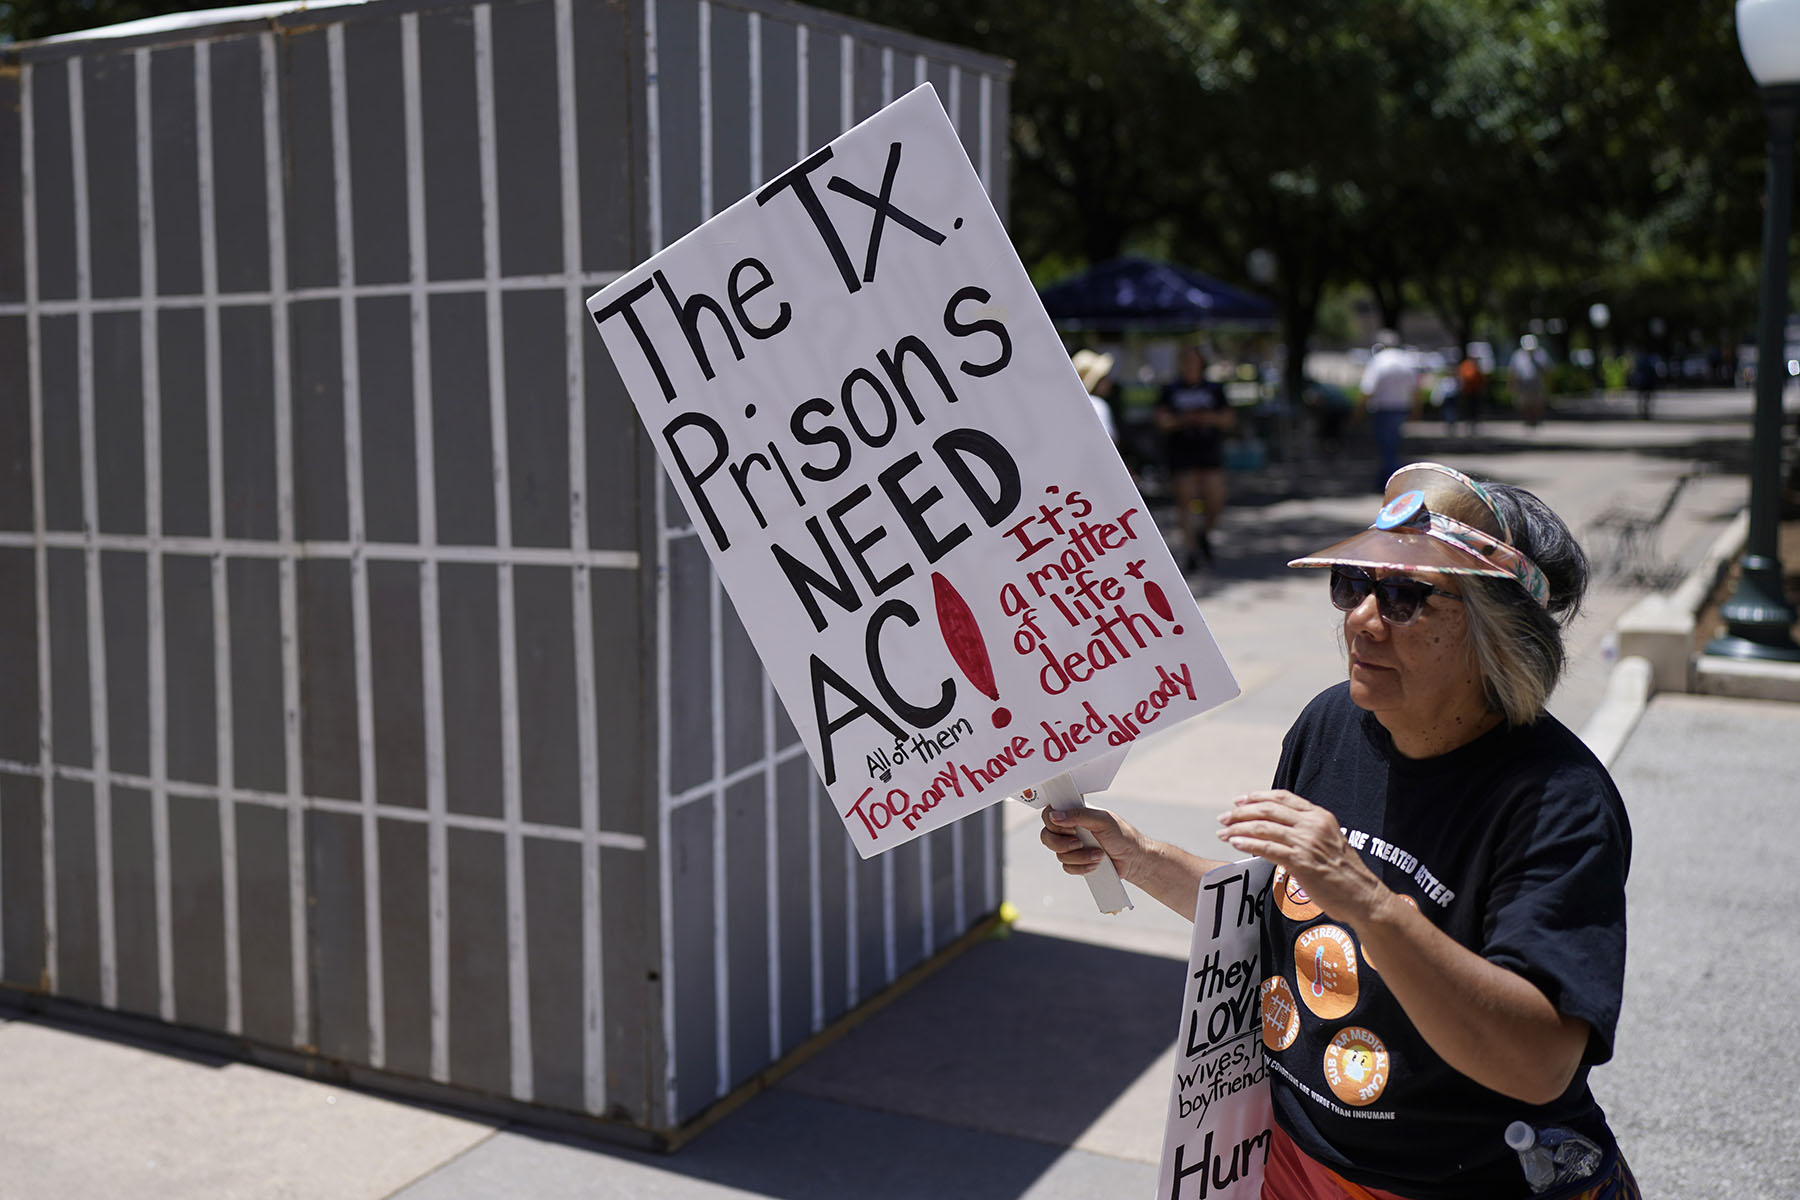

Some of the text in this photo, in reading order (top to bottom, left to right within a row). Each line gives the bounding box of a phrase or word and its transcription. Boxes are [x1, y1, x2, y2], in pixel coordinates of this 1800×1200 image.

[594, 142, 964, 403] The Tx.
[662, 286, 1012, 551] Prisons
[770, 428, 1022, 633] NEED
[1000, 508, 1138, 617] a matter
[1002, 485, 1093, 563] It's
[1014, 608, 1048, 655] of
[1050, 570, 1126, 627] life
[1040, 580, 1184, 695] death!
[845, 663, 1197, 840] Too many have died already
[866, 718, 974, 778] All of them
[1348, 829, 1369, 850] ARE
[1369, 837, 1418, 874] TREATED
[1194, 950, 1258, 1010] they
[1300, 927, 1356, 974] EXTREME HEAT
[1178, 1043, 1250, 1091] wives,
[1327, 1028, 1386, 1101] SUB PAR MEDICAL CARE
[1310, 1090, 1330, 1109] WORSE
[1330, 1102, 1352, 1118] THAN
[1352, 1110, 1396, 1120] INHUMANE
